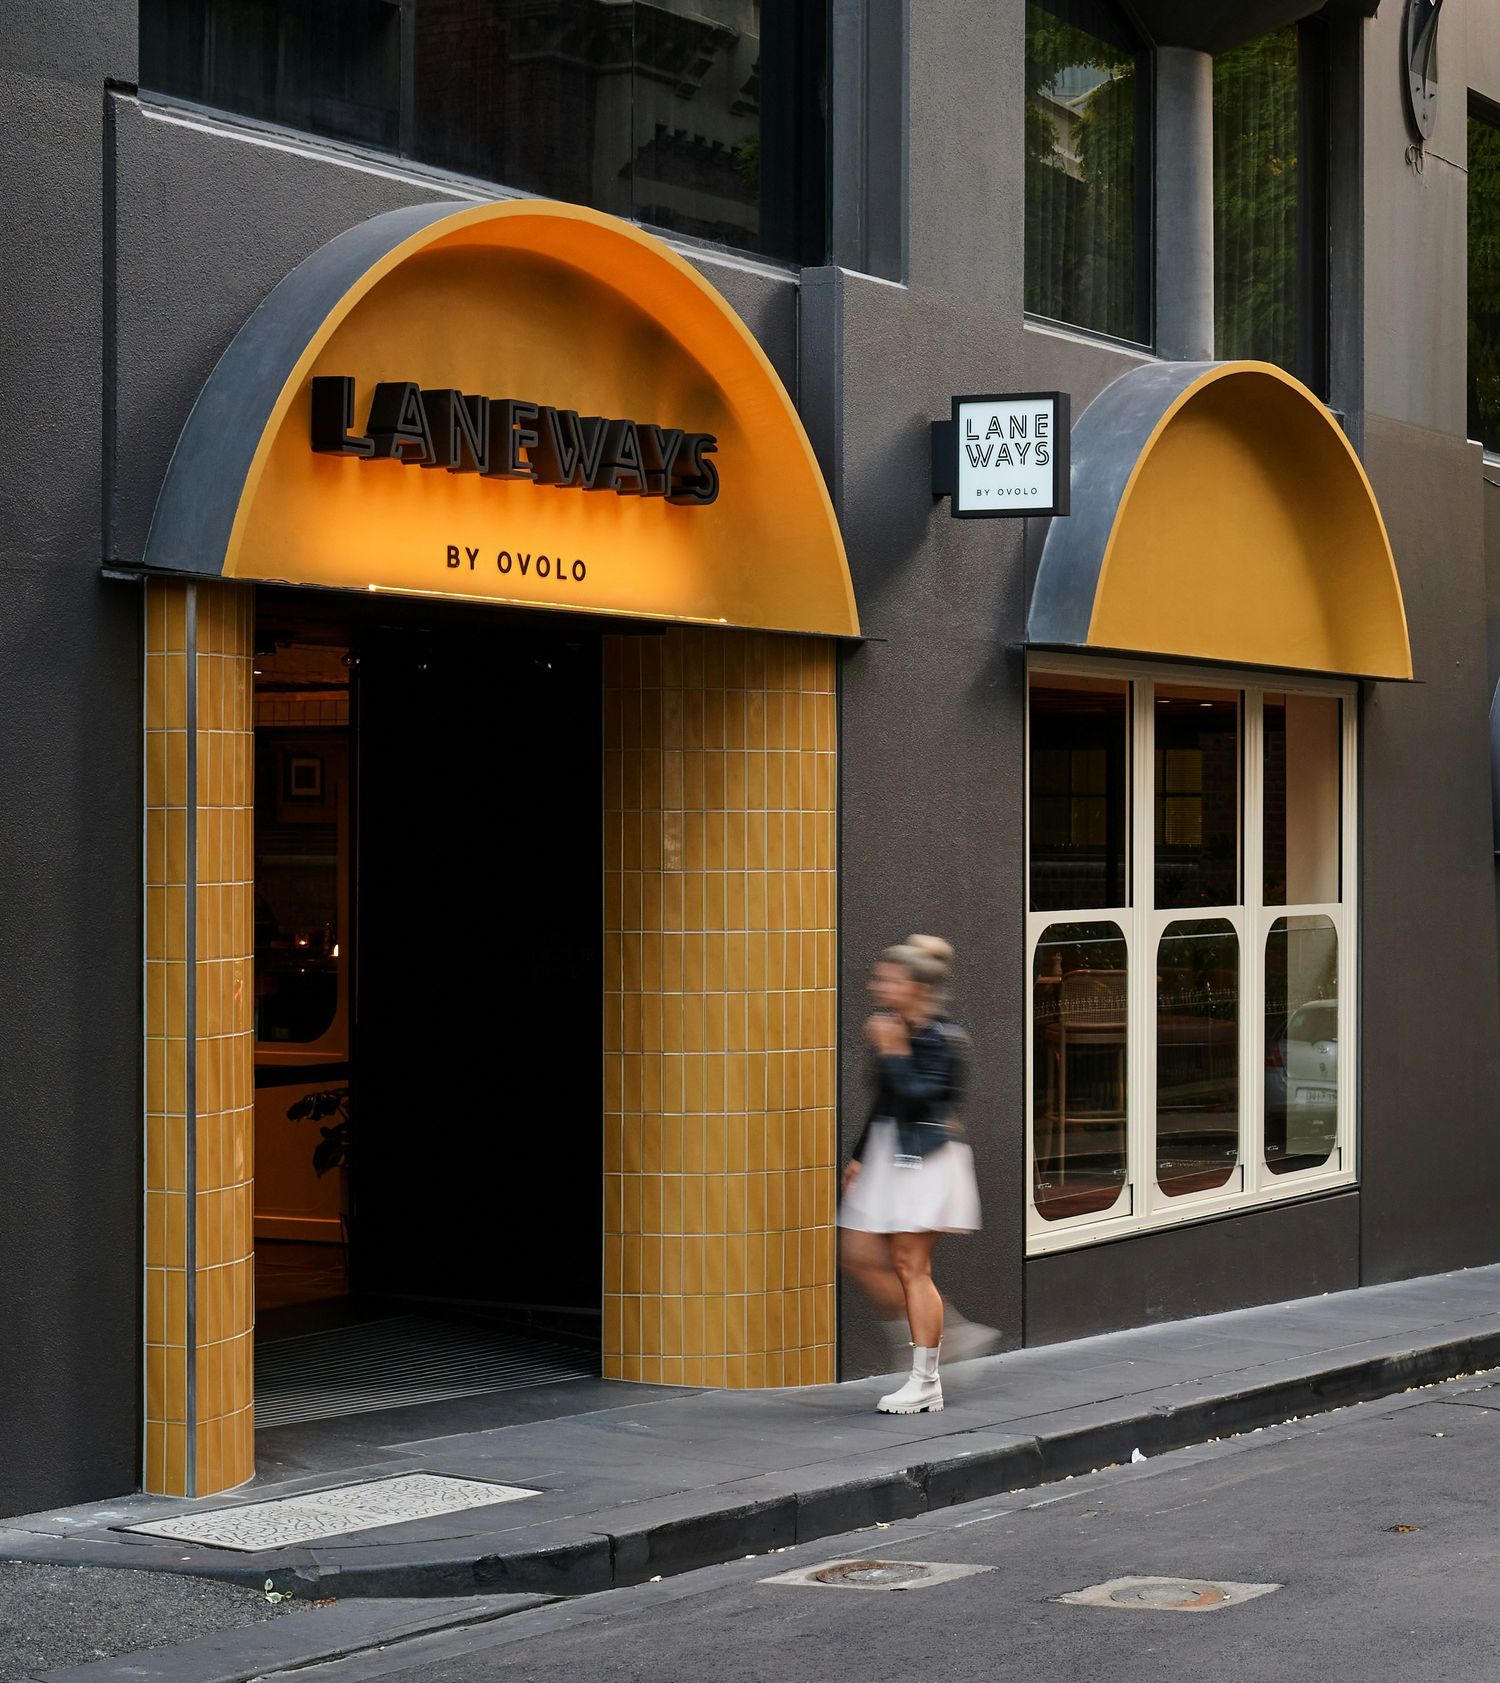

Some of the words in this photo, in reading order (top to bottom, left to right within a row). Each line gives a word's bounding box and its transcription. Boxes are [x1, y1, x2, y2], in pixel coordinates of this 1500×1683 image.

[312, 376, 719, 505] LANEWAYS
[966, 414, 1049, 441] LANE
[965, 441, 1050, 468] WAYS
[976, 489, 990, 497] BY
[997, 487, 1038, 496] OVOLO
[446, 545, 480, 571] BY
[497, 551, 587, 582] OVOLO
